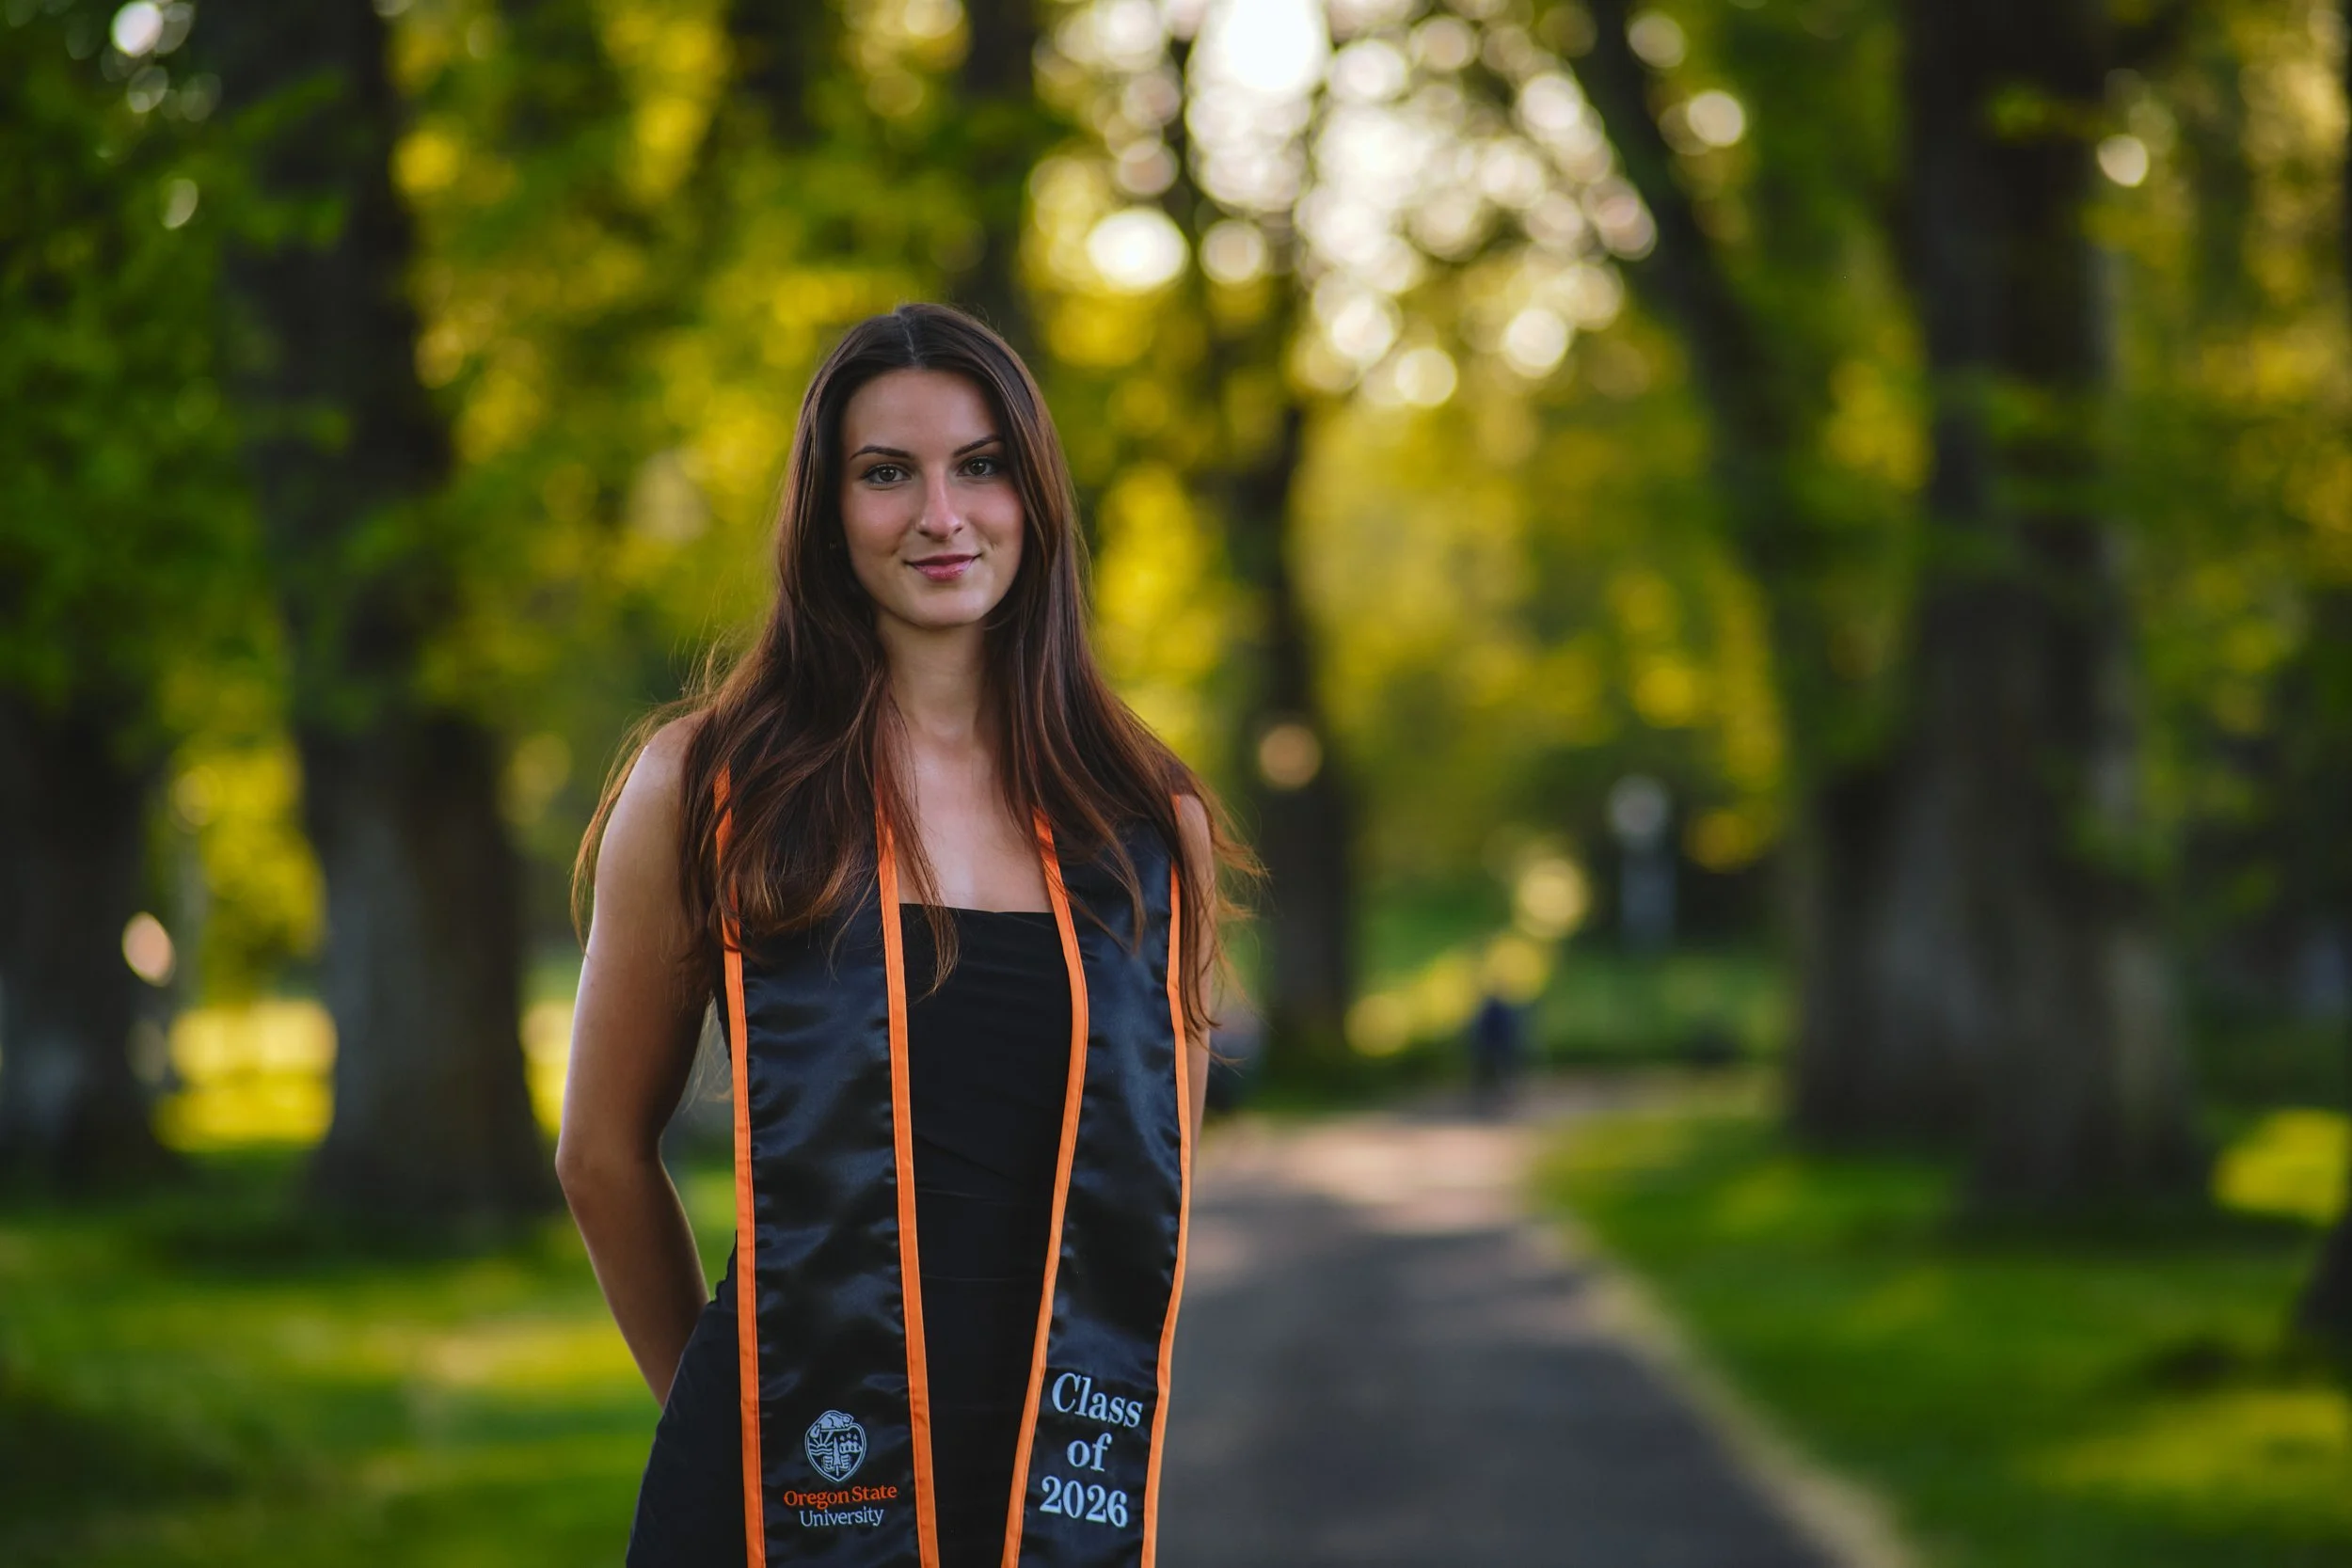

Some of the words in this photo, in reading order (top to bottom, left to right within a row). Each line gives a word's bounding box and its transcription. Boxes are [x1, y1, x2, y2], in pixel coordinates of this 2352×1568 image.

[1052, 1372, 1143, 1428] Class
[1067, 1433, 1112, 1472] of
[784, 1490, 850, 1510] Oregon
[851, 1485, 898, 1501] State
[800, 1505, 884, 1527] University
[1039, 1475, 1128, 1528] 2026
